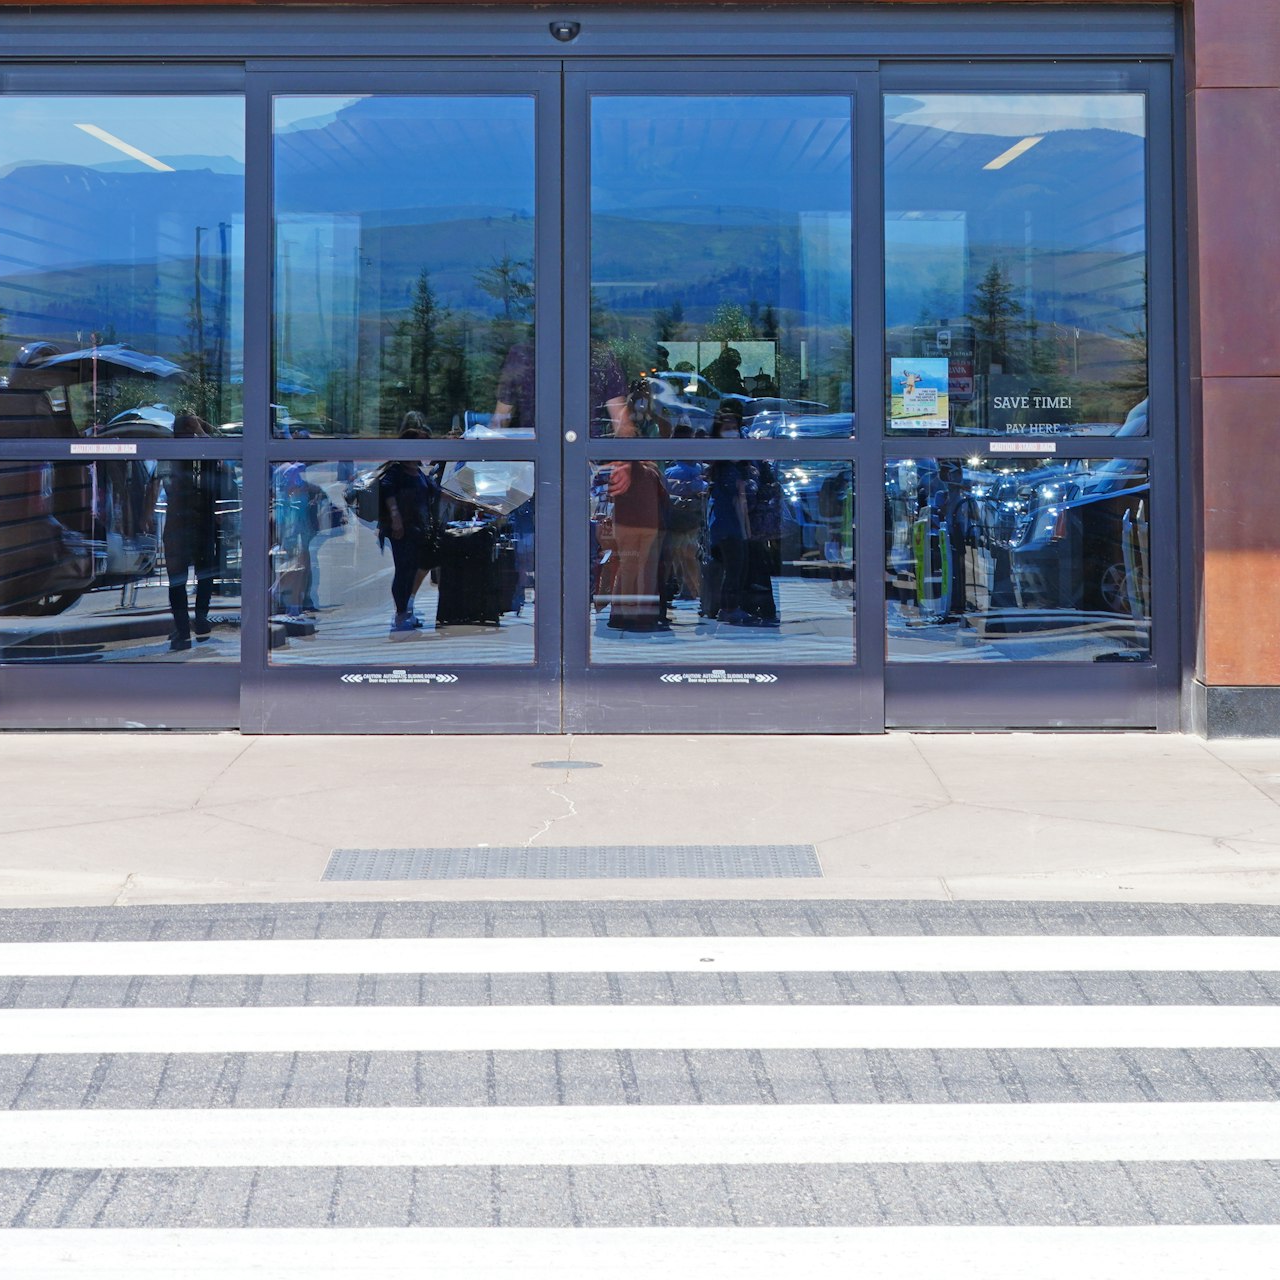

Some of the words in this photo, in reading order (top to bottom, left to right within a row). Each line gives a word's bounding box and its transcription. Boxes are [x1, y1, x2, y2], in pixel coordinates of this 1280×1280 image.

[994, 396, 1029, 409] SAVE
[1033, 396, 1072, 409] TIME!
[1006, 423, 1026, 434] PAY
[1029, 423, 1061, 434] HERE
